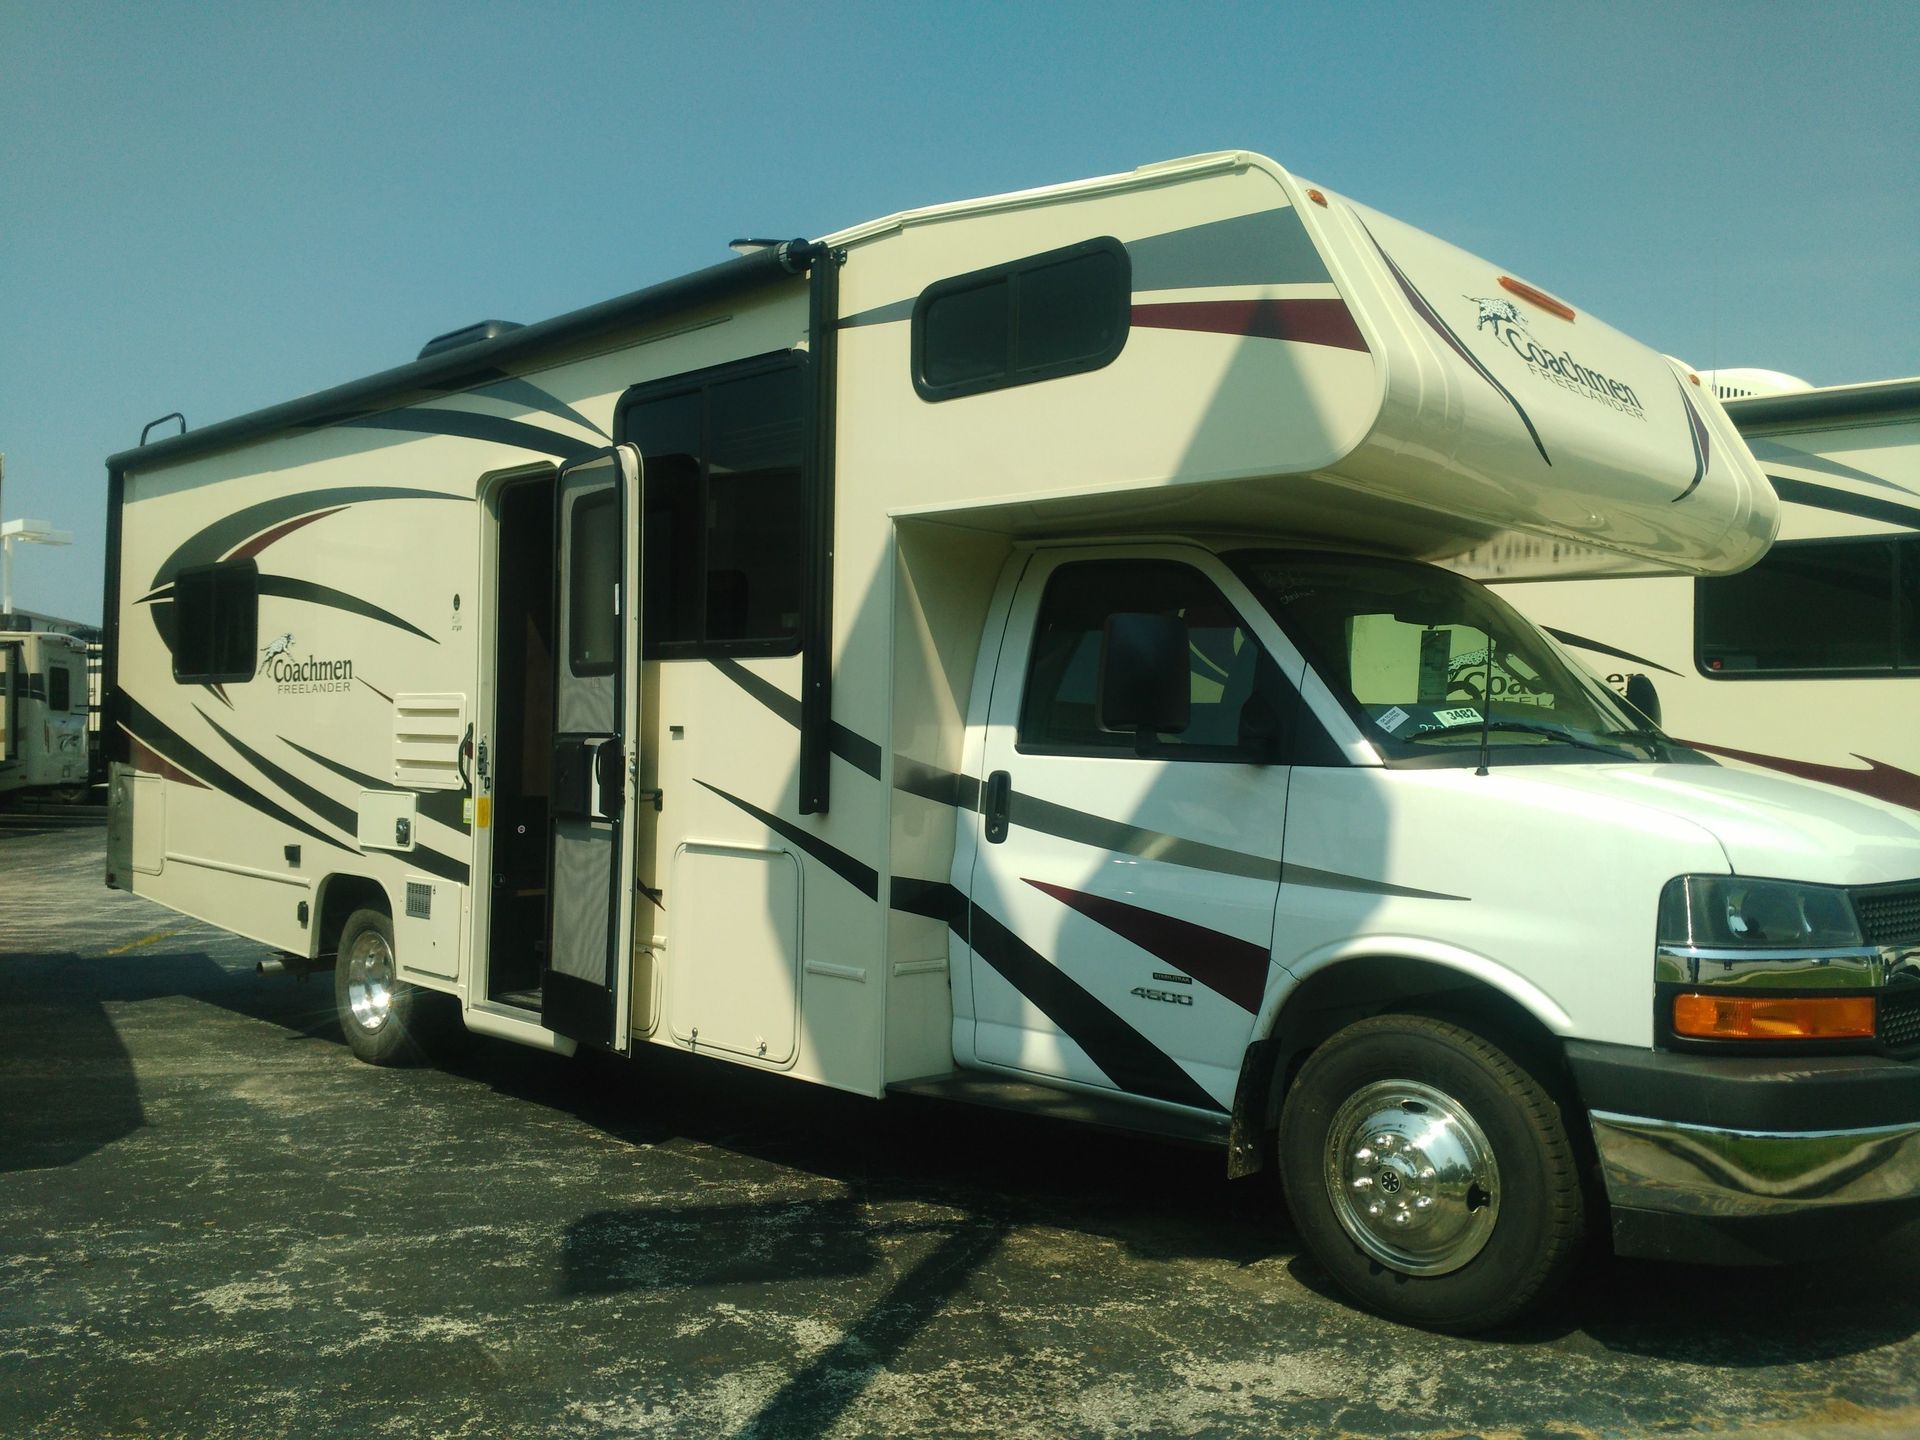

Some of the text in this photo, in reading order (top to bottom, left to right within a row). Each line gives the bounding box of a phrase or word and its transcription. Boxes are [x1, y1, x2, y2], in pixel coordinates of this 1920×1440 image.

[1506, 328, 1645, 411] Coachmen
[1527, 362, 1648, 422] FREELANDER
[273, 654, 353, 683] Coachmen
[277, 682, 352, 694] FREELANDER
[1446, 709, 1477, 721] 3482
